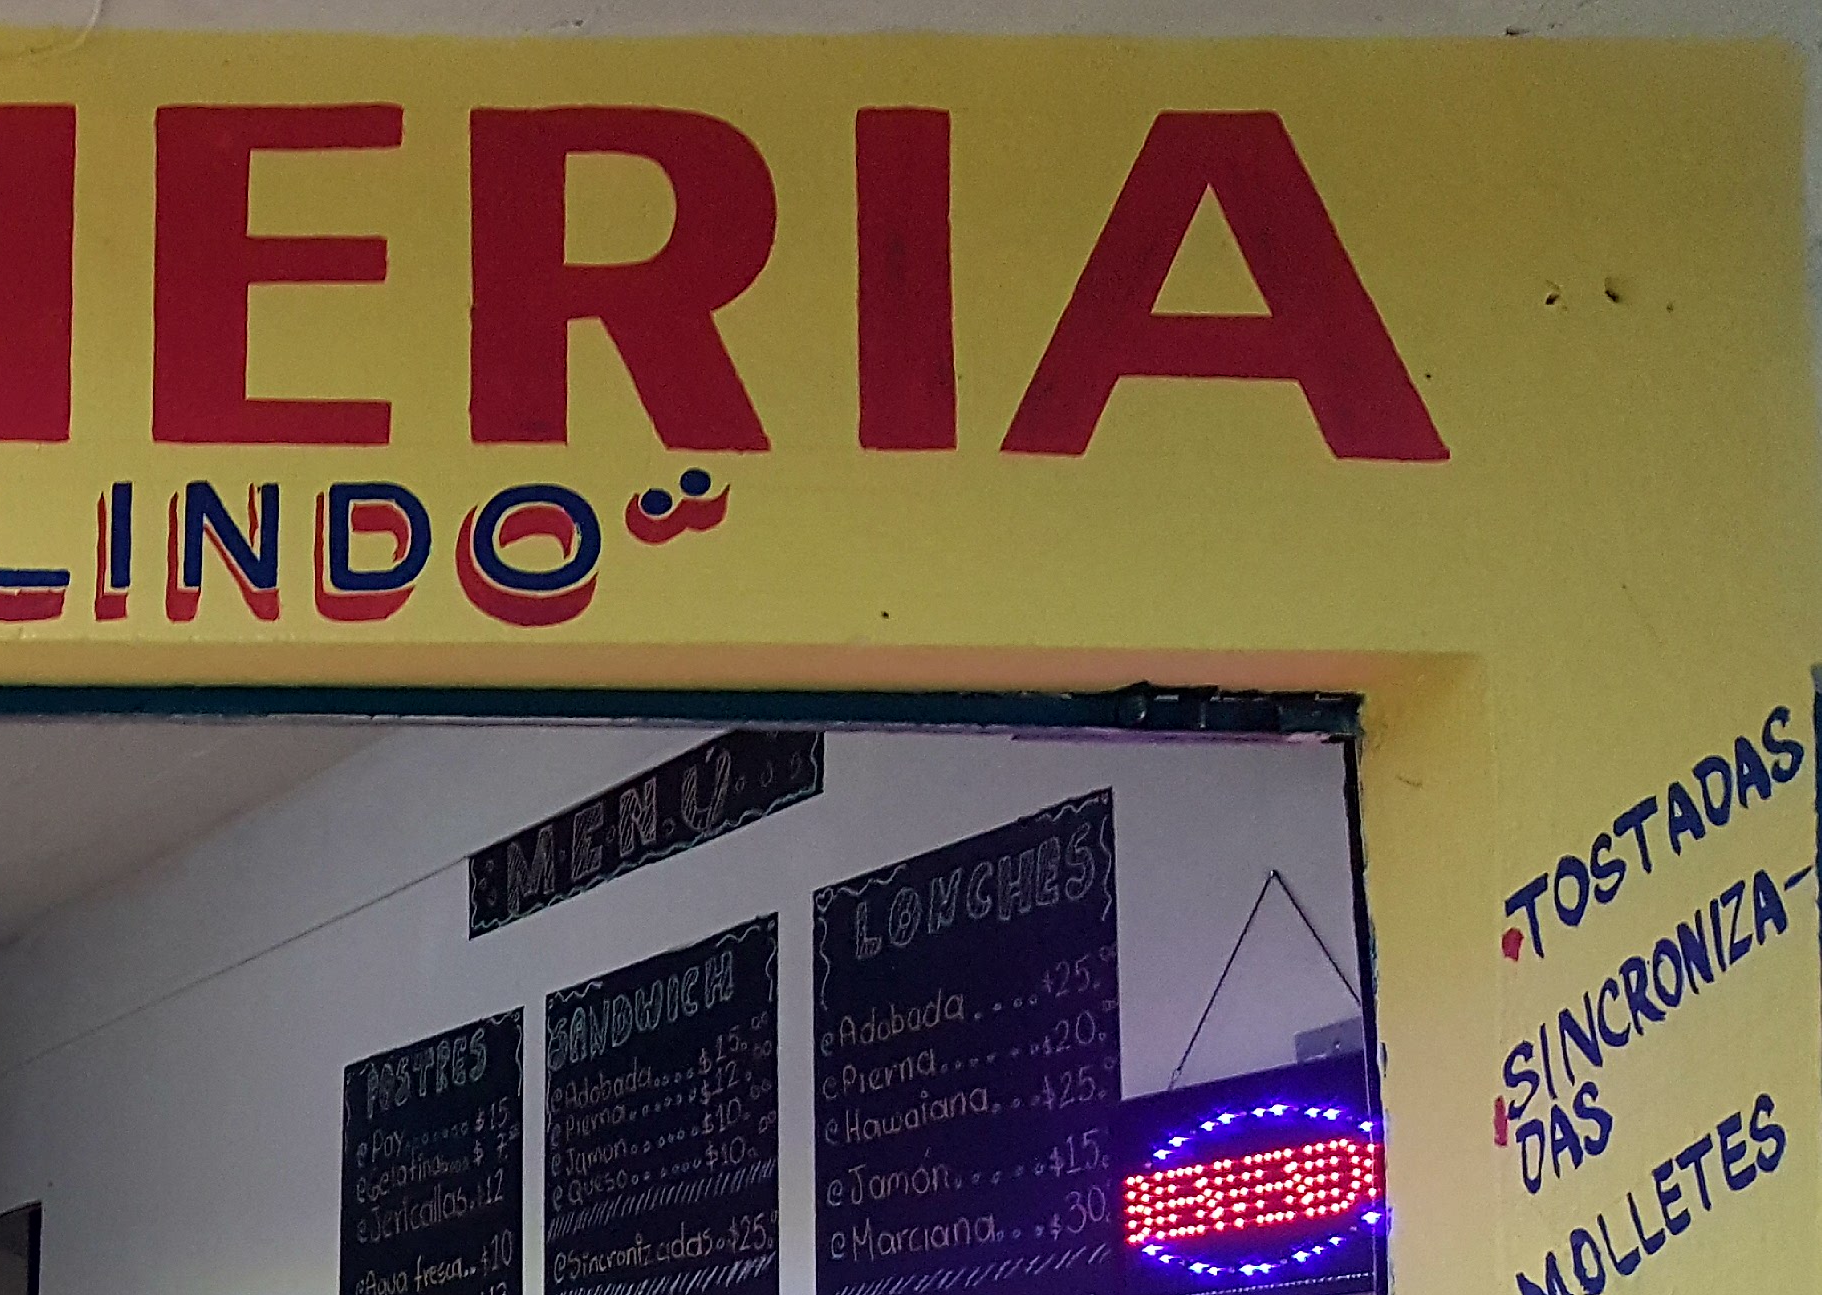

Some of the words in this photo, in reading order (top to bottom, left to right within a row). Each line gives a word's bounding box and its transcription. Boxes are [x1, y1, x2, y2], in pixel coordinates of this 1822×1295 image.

[854, 821, 1097, 962] LONCHES
[1504, 706, 1805, 958] TOSTADAS
[547, 950, 734, 1072] SANDWICH
[1503, 863, 1815, 1121] SINCRONIZA-
[1515, 1080, 1614, 1195] DAS
